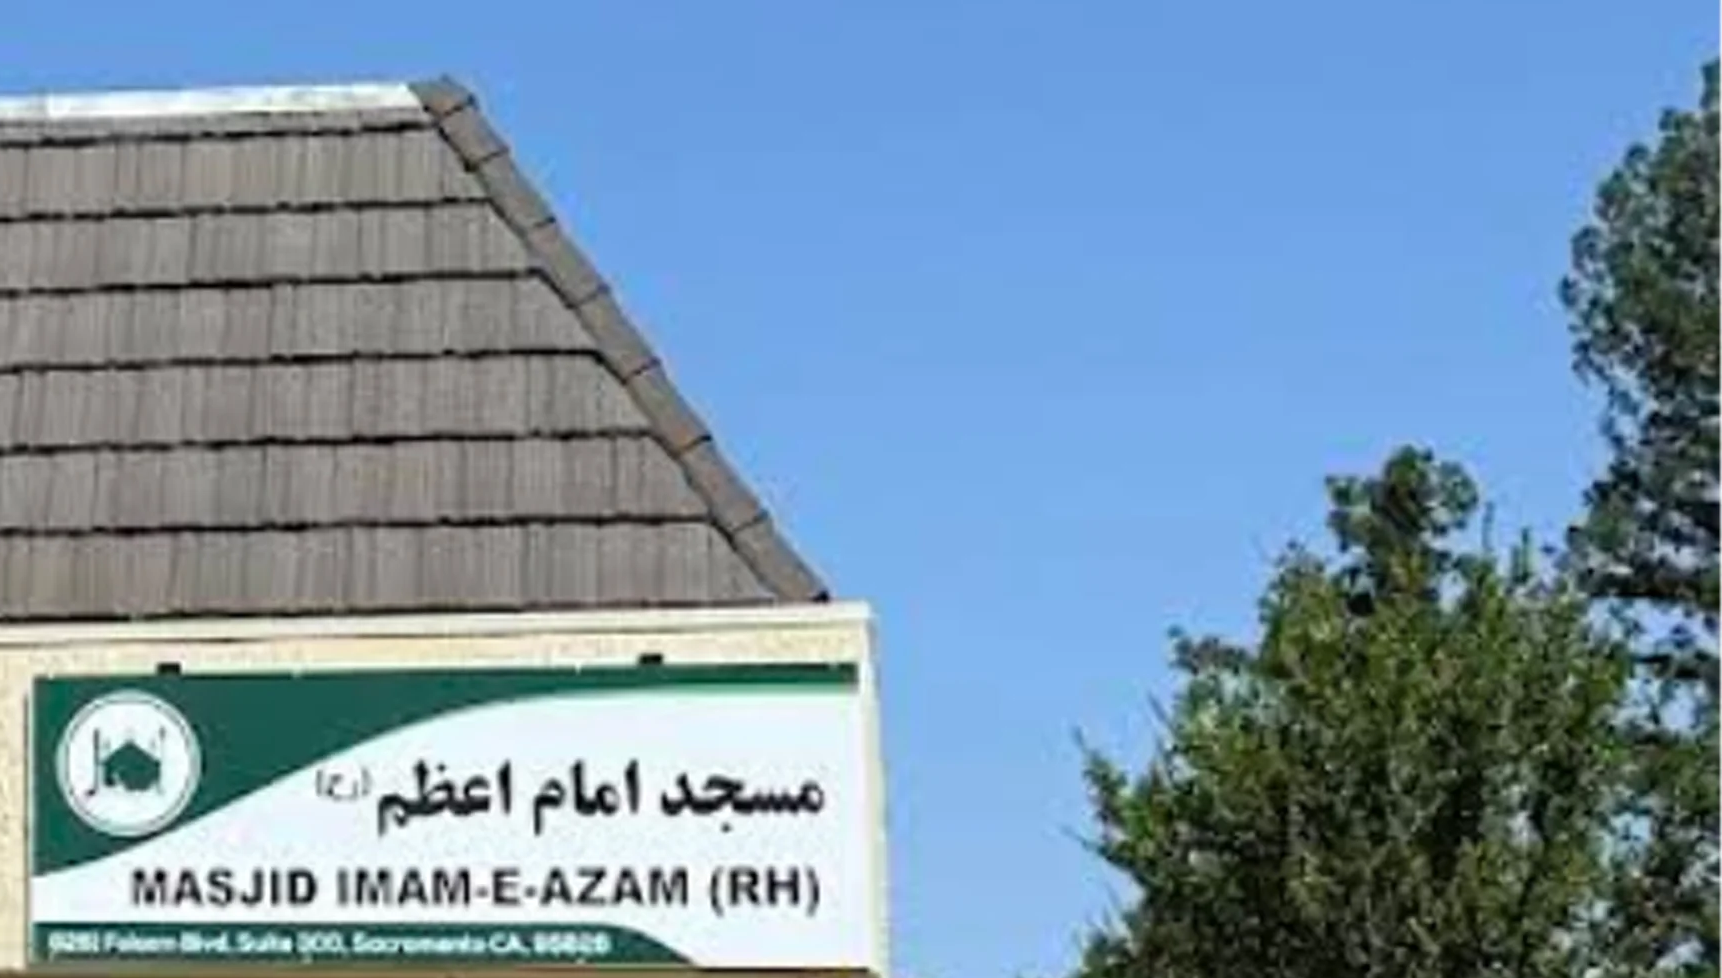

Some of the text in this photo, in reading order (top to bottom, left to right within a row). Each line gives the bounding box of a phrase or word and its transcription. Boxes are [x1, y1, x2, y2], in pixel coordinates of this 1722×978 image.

[377, 758, 512, 836] اعظم
[532, 758, 639, 836] امام
[659, 771, 825, 834] مسجد
[131, 864, 822, 917] MASJID IMAM-E-AZAM (RH)
